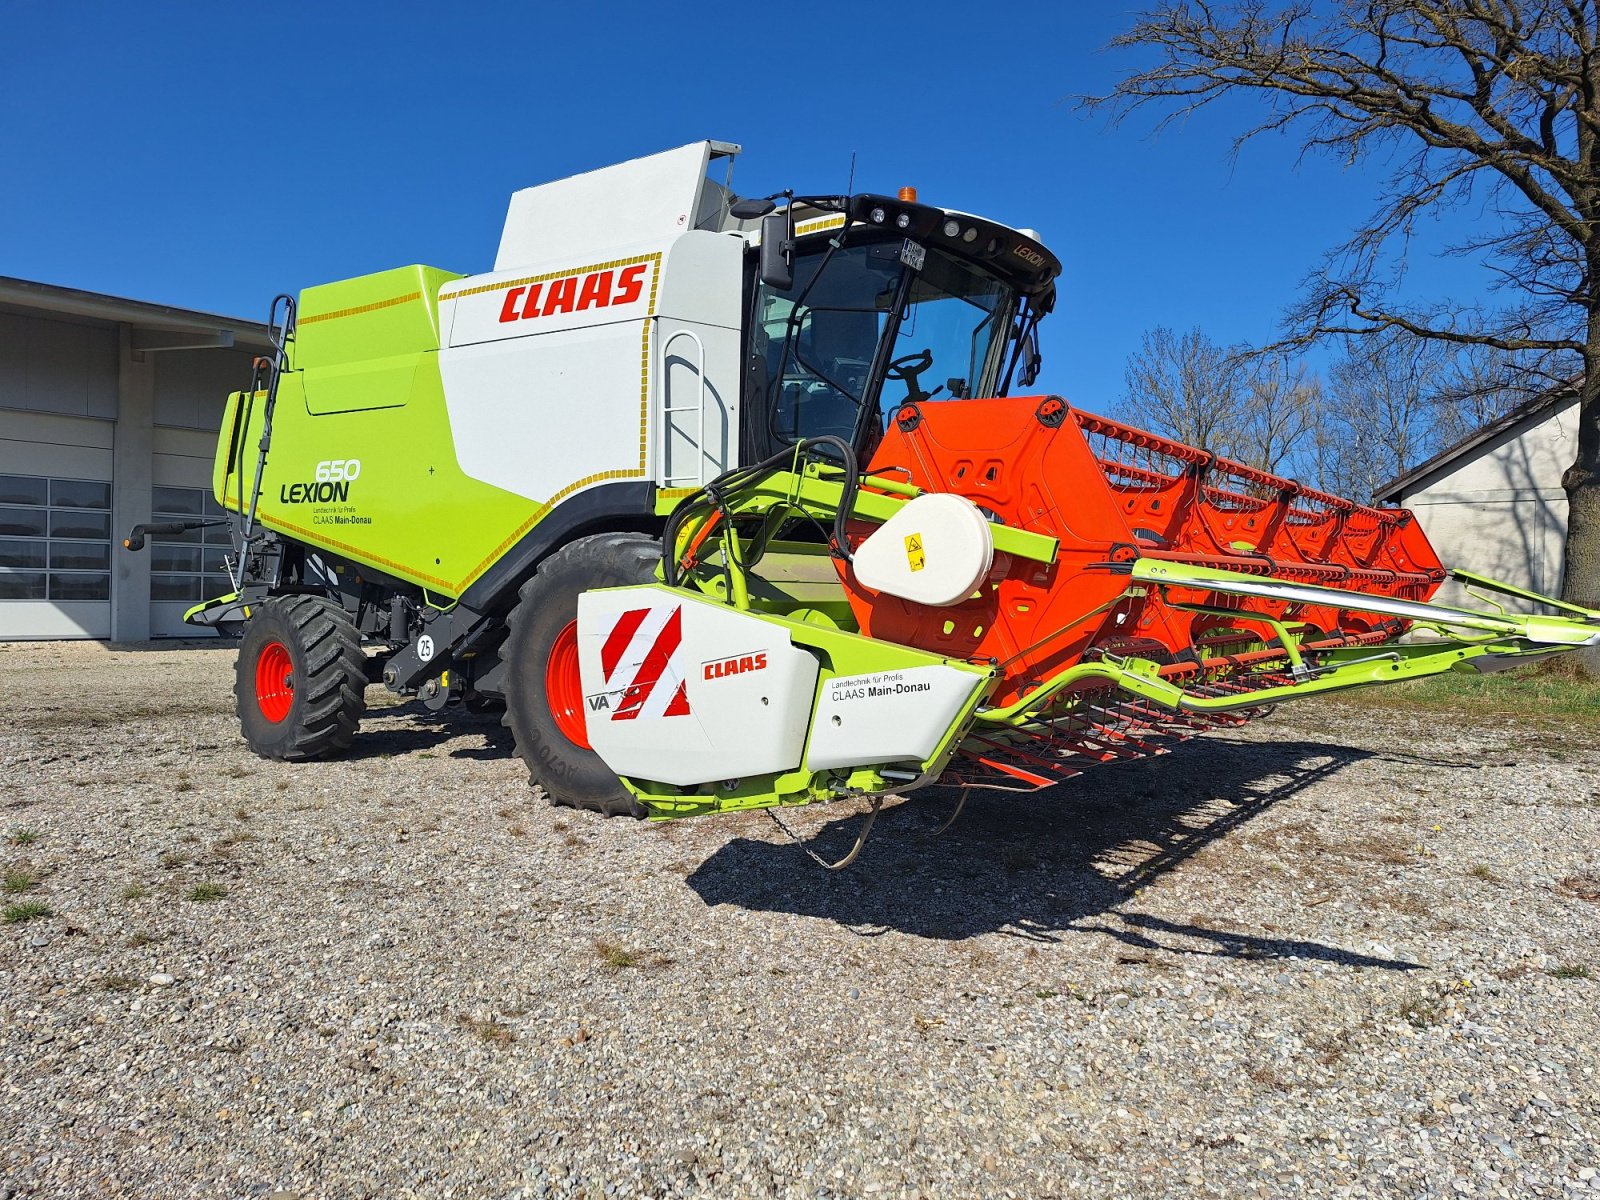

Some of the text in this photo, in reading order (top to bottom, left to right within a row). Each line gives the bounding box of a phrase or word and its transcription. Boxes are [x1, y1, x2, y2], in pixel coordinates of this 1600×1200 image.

[1013, 244, 1046, 267] LEXION
[498, 264, 648, 323] CLAAS
[315, 459, 361, 482] 650
[280, 481, 350, 503] LEXION
[313, 516, 372, 524] CLAAS Main-Donau
[421, 639, 430, 657] 25
[704, 653, 767, 681] CLAAS
[831, 674, 903, 689] Landtechnik für Profis
[832, 682, 931, 701] CLAAS Main-Donau
